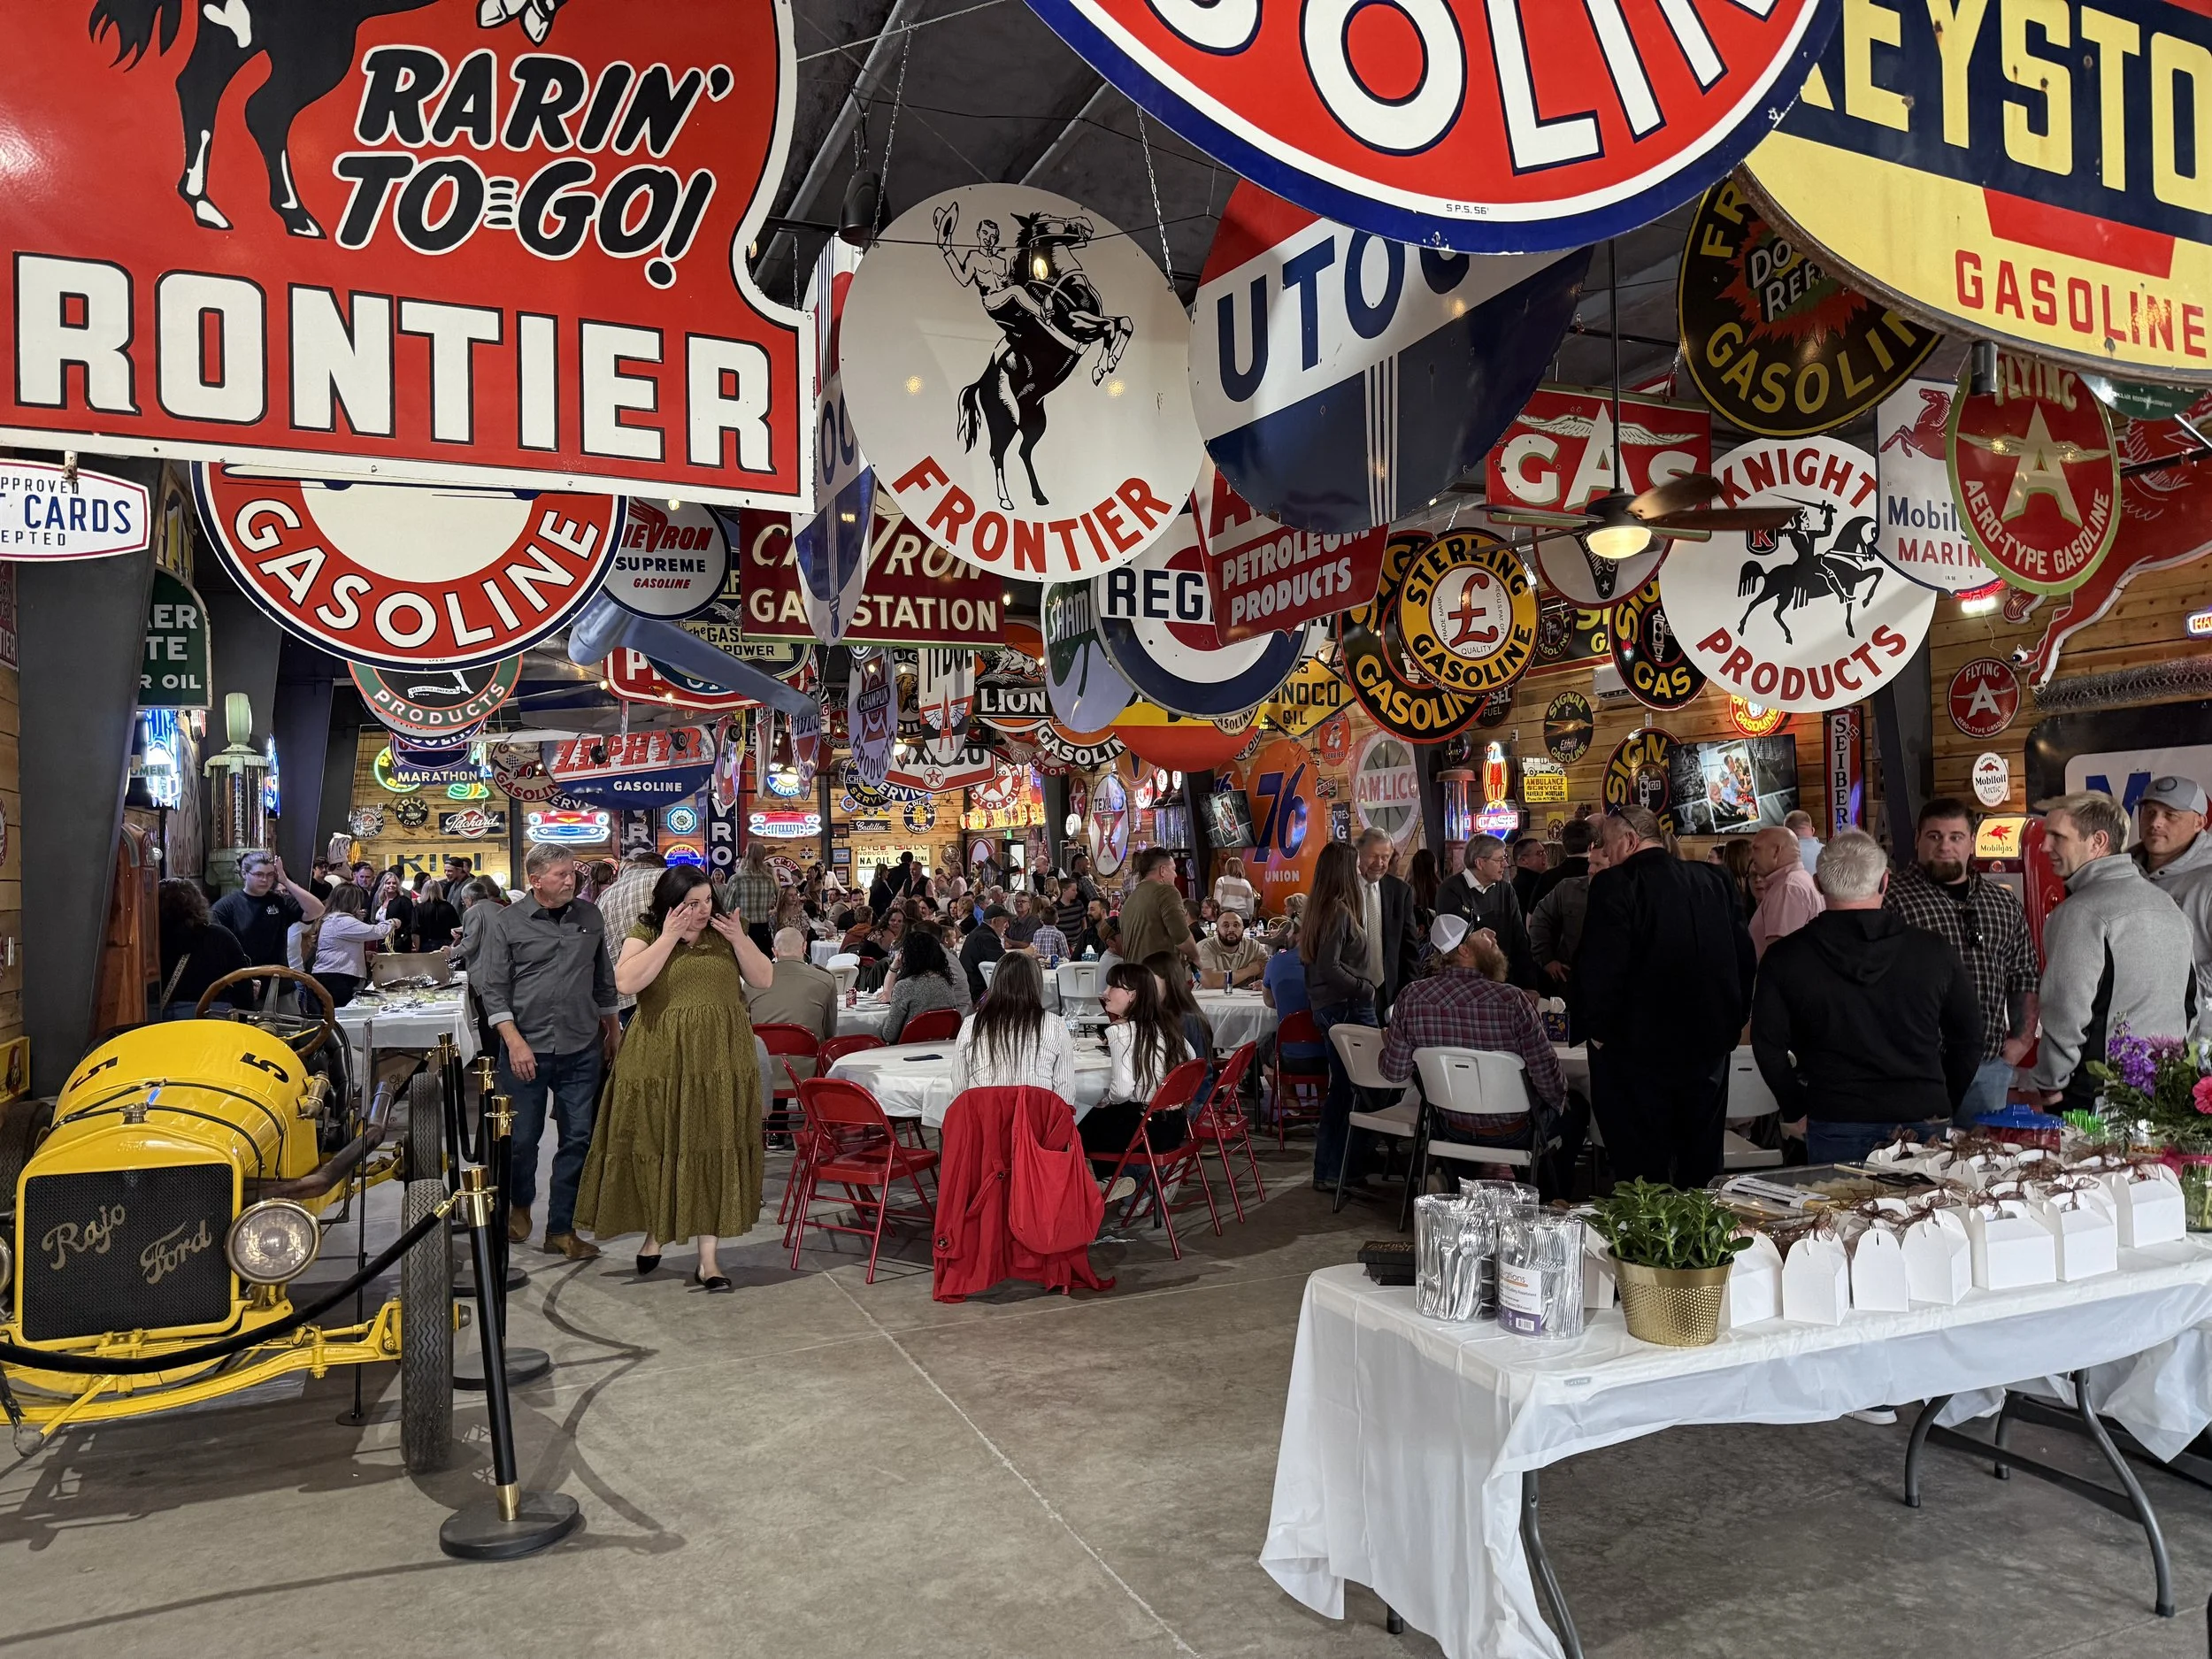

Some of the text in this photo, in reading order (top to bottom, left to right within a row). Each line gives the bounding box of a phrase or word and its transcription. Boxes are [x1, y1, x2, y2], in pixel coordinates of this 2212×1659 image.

[354, 44, 735, 157] RARIN'
[1800, 0, 2212, 214] EYSTO
[332, 151, 716, 289] TO GO!
[1954, 249, 2208, 359] GASOLINE
[12, 250, 776, 475] RONTIER
[1717, 447, 1878, 510] KNIGHT
[24, 494, 132, 534] CARDS
[891, 456, 1172, 573] FRONTIER
[1965, 480, 2110, 575] AERO-TYPE GASOLINE
[616, 557, 706, 572] SUPREME
[1898, 537, 1989, 568] MARIN
[234, 498, 601, 649] GASOLINE
[633, 578, 692, 589] GASOLINE
[1406, 537, 1528, 607] STERLING
[1107, 566, 1214, 622] REG
[1231, 557, 1352, 627] PRODUCTS
[749, 588, 998, 634] GA STATION
[707, 626, 743, 643] GAS
[723, 645, 774, 657] POWER
[1413, 623, 1532, 688] GASOLINE
[1461, 645, 1492, 655] QUALITY
[1695, 623, 1908, 703] PRODUCTS
[161, 674, 202, 690] OIL
[1633, 661, 1691, 699] GAS
[1964, 663, 2001, 682] FLYING
[373, 682, 505, 725] PRODUCTS
[859, 686, 890, 710] CHAMPLIN
[980, 687, 1047, 713] LION
[1549, 692, 1586, 718] SIGNAL
[1483, 708, 1502, 718] FUEL
[1735, 708, 1778, 733] GASOLINE
[1956, 710, 2011, 734] AERO-TYPE GASOLINE
[853, 726, 895, 780] PRODUCTS
[1551, 741, 1587, 764] GASOLINE
[1559, 737, 1578, 753] Ethyl
[397, 771, 478, 782] MARATHON
[613, 780, 682, 793] GASOLINE
[1834, 717, 1849, 832] SEIBER
[1005, 786, 1019, 803] OIL
[1983, 784, 2001, 795] Arctic
[397, 796, 427, 812] POLLY
[1252, 761, 1308, 863] 76
[445, 812, 501, 833] Packard
[856, 820, 886, 831] Cadillac
[909, 824, 931, 833] SERVICE
[1980, 844, 2013, 855] Mobilgas
[1264, 869, 1300, 883] UNION
[239, 1051, 290, 1084] 5
[41, 1203, 127, 1271] Rajo
[140, 1219, 212, 1285] Ford
